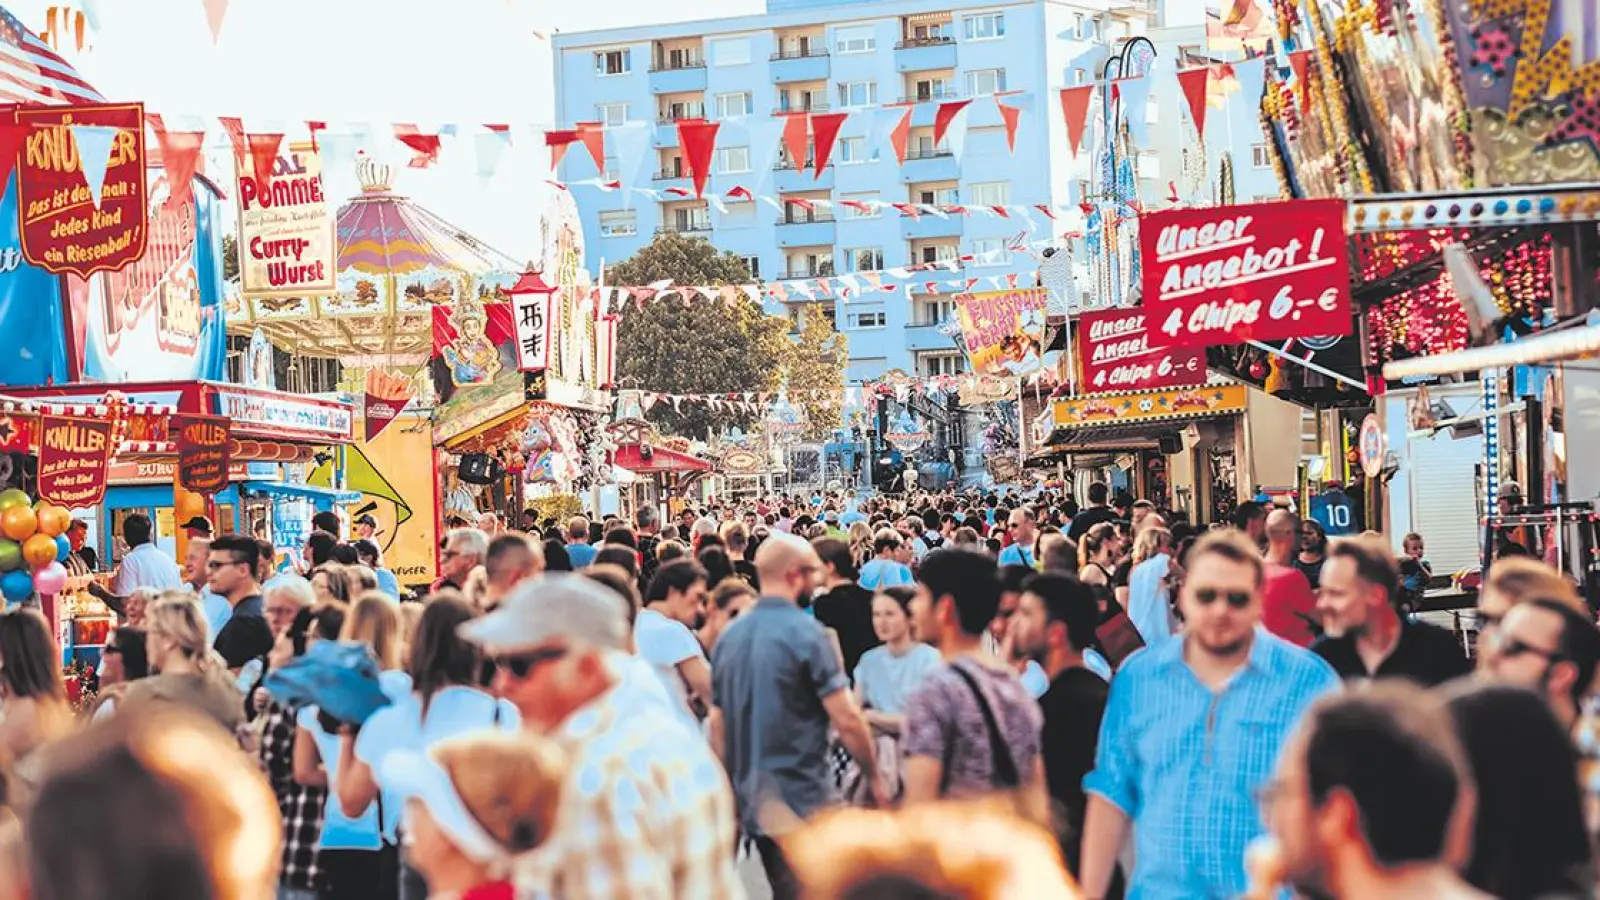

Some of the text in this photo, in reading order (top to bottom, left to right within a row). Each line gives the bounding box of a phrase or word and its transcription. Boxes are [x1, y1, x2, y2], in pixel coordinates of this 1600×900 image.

[27, 113, 137, 172] KNÜER
[27, 198, 51, 218] Das
[53, 188, 69, 208] ist
[100, 180, 127, 198] nall
[50, 206, 122, 238] Jedes Kind
[1156, 216, 1254, 256] Unser
[43, 247, 64, 263] ein
[250, 235, 309, 261] Curry-
[267, 260, 324, 286] Wurst
[1160, 238, 1303, 293] Angebot
[1090, 315, 1147, 339] Unser
[1162, 307, 1183, 337] 4
[1187, 298, 1262, 333] Chips
[1093, 370, 1106, 387] 4
[1109, 364, 1153, 385] Chips
[45, 420, 105, 453] KNÜLLER
[1326, 504, 1349, 527] 10
